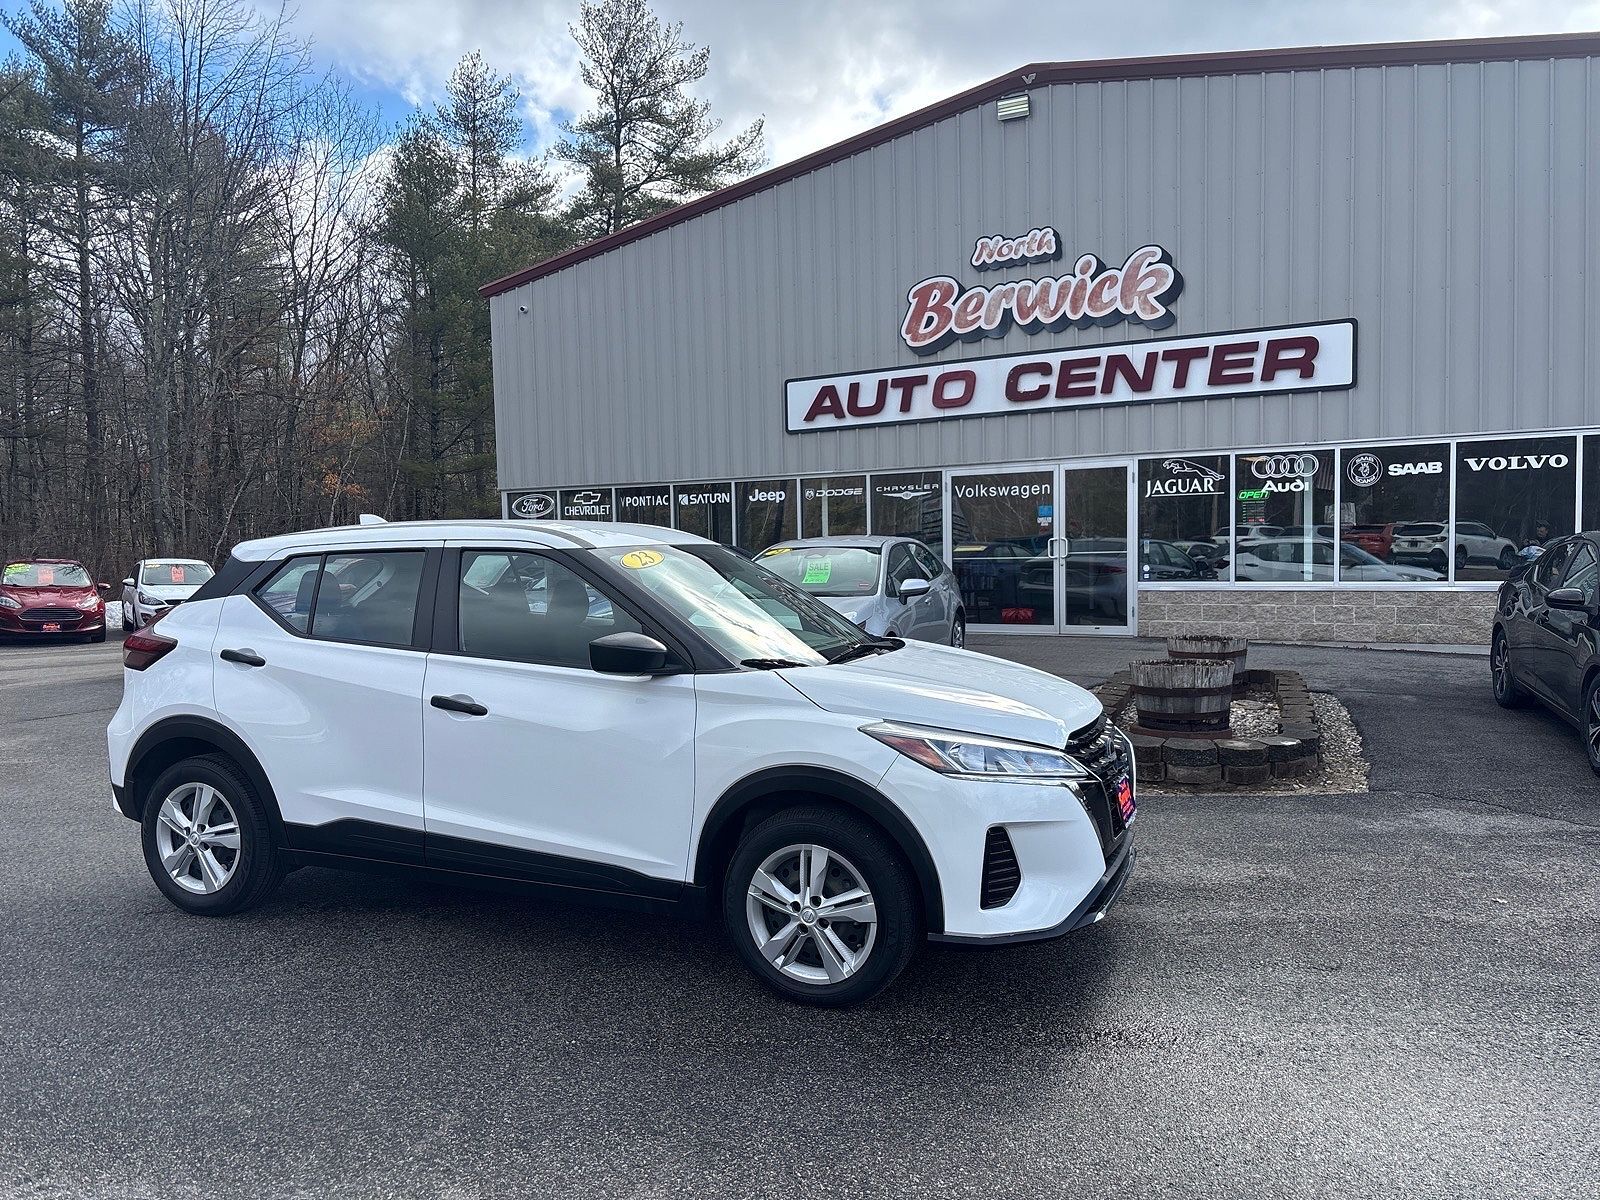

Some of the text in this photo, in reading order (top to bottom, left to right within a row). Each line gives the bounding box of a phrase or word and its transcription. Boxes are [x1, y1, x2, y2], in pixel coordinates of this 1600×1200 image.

[973, 228, 1056, 265] North
[904, 246, 1176, 346] Berwick
[803, 336, 1320, 422] AUTO CENTER
[1388, 462, 1442, 476] SAAB
[1464, 454, 1569, 471] VOLVO
[816, 488, 863, 497] DODGE
[876, 483, 939, 492] CHRYSLER
[954, 482, 1051, 499] Volkswagen
[1145, 477, 1215, 498] JAGUAR
[1260, 479, 1309, 493] Audi
[626, 495, 669, 507] PONTIAC
[690, 493, 730, 505] SATURN
[749, 489, 786, 504] Jeep
[1239, 491, 1269, 499] OPEN
[521, 498, 544, 513] Ford
[564, 505, 611, 516] CHEVROLET
[630, 551, 655, 566] 23
[808, 562, 829, 572] SALE
